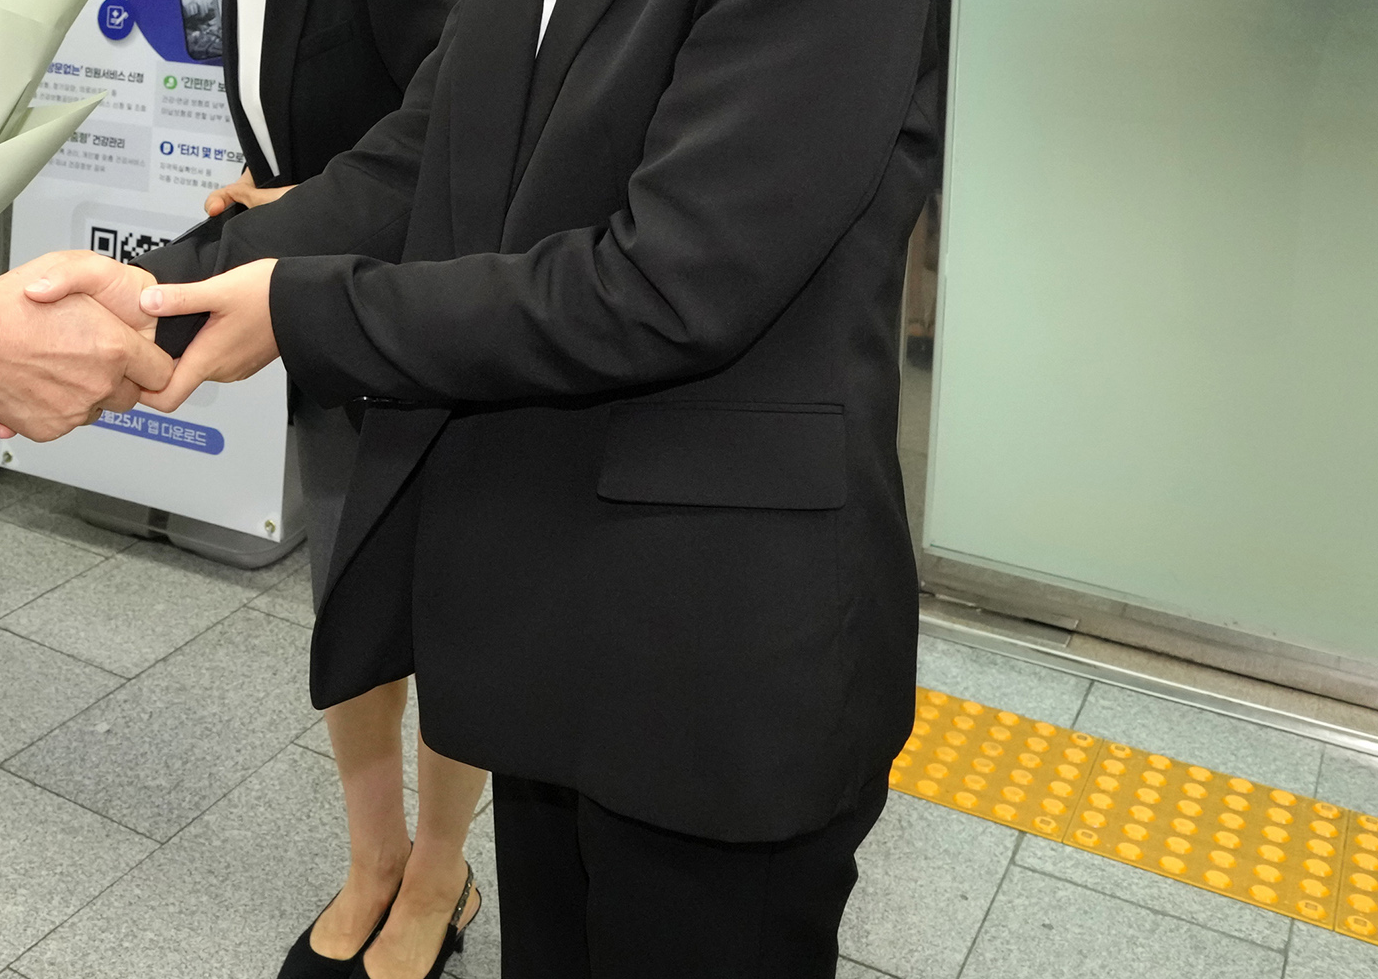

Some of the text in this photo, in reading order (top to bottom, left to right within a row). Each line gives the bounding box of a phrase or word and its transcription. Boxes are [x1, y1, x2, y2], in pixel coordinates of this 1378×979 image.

[84, 67, 126, 82] 민원서비스
[127, 72, 144, 84] 신청
[92, 134, 126, 149] 건강관리
[147, 419, 159, 435] 앱
[161, 423, 207, 447] 다운로드
